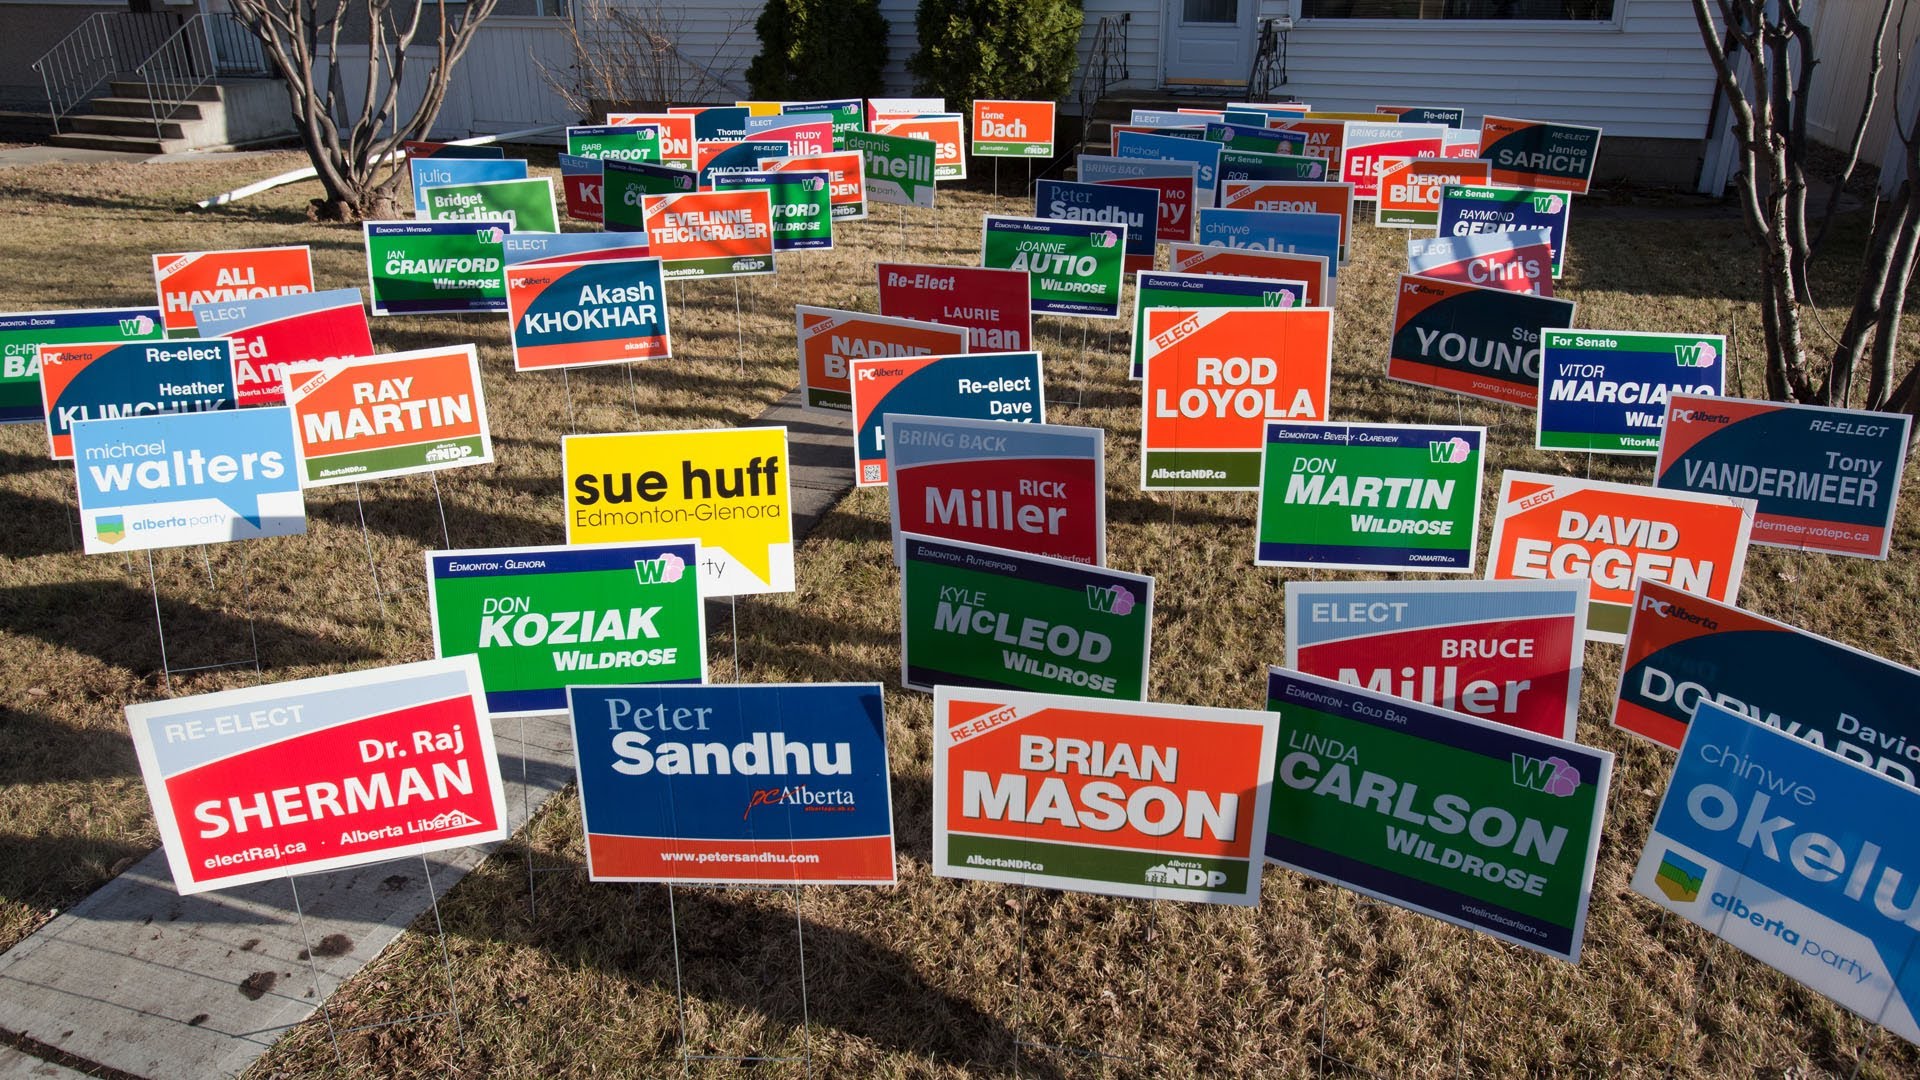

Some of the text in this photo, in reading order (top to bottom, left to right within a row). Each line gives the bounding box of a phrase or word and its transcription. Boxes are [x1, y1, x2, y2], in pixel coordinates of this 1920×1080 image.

[981, 112, 1004, 120] Lorne
[1134, 116, 1160, 124] ELECT
[1423, 111, 1458, 120] Re-elect
[716, 128, 746, 136] Thomas
[795, 132, 822, 140] RUDY
[981, 118, 1027, 138] Dach
[1350, 128, 1403, 138] BRING BACK
[1552, 131, 1591, 142] RE-ELECT
[600, 148, 651, 160] GROOT
[850, 136, 891, 153] dennis
[1122, 145, 1160, 157] michael
[1548, 144, 1588, 156] Janice
[562, 157, 589, 168] ELECT
[1238, 156, 1263, 164] Senate
[1418, 150, 1435, 159] MO
[1498, 149, 1586, 174] SARICH
[418, 168, 451, 186] julia
[1084, 163, 1117, 174] BRING
[1118, 165, 1145, 176] BACK
[1228, 172, 1249, 181] ROB
[1388, 162, 1405, 174] ELECT
[626, 183, 647, 192] JOHN
[1406, 174, 1460, 186] DERON
[434, 192, 484, 209] Bridget
[876, 187, 898, 197] party
[1050, 185, 1093, 204] Peter
[1166, 189, 1186, 200] MO
[1233, 188, 1252, 201] ELECT
[1449, 188, 1495, 199] For Senate
[650, 200, 668, 214] ELECT
[1049, 200, 1144, 228] Sandhu
[1254, 200, 1318, 212] DERON
[1459, 209, 1514, 222] RAYMOND
[664, 209, 752, 228] EVELINNE
[994, 222, 1021, 230] EDMONTON
[376, 226, 404, 234] EDMONTON
[652, 223, 768, 244] TEICHGRABER
[1205, 222, 1250, 236] chinwe
[506, 240, 548, 251] ELECT
[1016, 241, 1067, 254] JOANNE
[1411, 242, 1454, 256] ELECT
[387, 250, 406, 261] IAN
[1010, 252, 1098, 277] AUTIO
[1184, 254, 1206, 268] ELECT
[166, 257, 190, 275] ELECT
[385, 258, 500, 276] CRAWFORD
[1467, 255, 1541, 284] Chris
[216, 266, 256, 287] ALI
[433, 278, 500, 290] WILDROSE
[887, 272, 956, 292] Re-Elect
[1040, 278, 1107, 294] WILDROSE
[1148, 278, 1204, 290] EDMONTON CALDER
[578, 281, 655, 306] Akash
[30, 318, 56, 326] DECORE
[200, 306, 248, 324] ELECT
[524, 304, 658, 335] KHOKHAR
[944, 306, 1000, 322] LAURIE
[812, 319, 835, 335] ELECT
[1155, 315, 1201, 350] ELECT
[232, 336, 268, 360] Ed
[624, 341, 660, 351] akash.ca
[1552, 335, 1618, 349] For Senate
[42, 352, 94, 366] PCAlberta
[146, 346, 222, 363] Re-elect
[858, 368, 904, 382] PCAlberta
[1196, 357, 1278, 386] ROD
[1558, 362, 1606, 378] VITOR
[160, 382, 225, 397] Heather
[302, 373, 328, 396] ELECT
[352, 376, 414, 406] RAY
[958, 376, 1031, 395] Re-elect
[990, 400, 1032, 416] Dave
[1156, 388, 1318, 420] LOYOLA
[302, 393, 473, 445] MARTIN
[1671, 408, 1731, 425] PCAlberta
[1278, 429, 1320, 440] EDMONTON
[1359, 432, 1399, 444] CLAREVIEW
[1809, 418, 1890, 438] RE-ELECT
[85, 440, 166, 460] michael
[898, 430, 956, 448] BRING
[958, 432, 1008, 452] BACK
[88, 449, 286, 493] walters
[319, 464, 368, 478] AlbertaNDP.ca
[1151, 468, 1227, 480] AlbertaNDP.ca
[1292, 457, 1337, 474] DON
[1826, 450, 1884, 479] Tony
[574, 455, 780, 506] sue huff
[1019, 478, 1068, 500] RICK
[1684, 458, 1879, 509] VANDERMEER
[1284, 474, 1456, 510] MARTIN
[1519, 488, 1557, 511] ELECT
[576, 502, 781, 528] Edmonton-Glenora
[924, 485, 1068, 536] Miller
[132, 513, 227, 532] alberta party
[1350, 514, 1454, 536] WILDROSE
[1557, 510, 1680, 552] DAVID
[449, 558, 546, 572] EDMONTON GLENORA
[917, 546, 1018, 573] EDMONTON RUTHERFORD
[1408, 553, 1456, 564] DONMARTIN.CA
[1510, 537, 1715, 598] EGGEN
[482, 596, 531, 615] DON
[940, 585, 987, 608] KYLE
[1312, 602, 1409, 624] ELECT
[1640, 594, 1718, 631] PCAlberta
[478, 606, 664, 648] KOZIAK
[1440, 638, 1535, 659] BRUCE
[552, 647, 678, 672] WILDROSE
[1002, 649, 1118, 694] WILDROSE
[1336, 665, 1532, 714] Miller
[1286, 683, 1408, 726] EDMONTON GOLD BAR
[164, 704, 306, 744] RE-ELECT
[604, 697, 714, 732] Peter
[950, 705, 1018, 744] RE-ELECT
[358, 724, 466, 764] Dr. Raj
[610, 730, 854, 776] Sandhu
[1289, 728, 1360, 766] LINDA
[1019, 734, 1180, 784] BRIAN
[1700, 742, 1818, 808] chinwe
[194, 758, 474, 840] SHERMAN
[962, 769, 1240, 843] MASON
[1278, 751, 1570, 866] CARLSON
[204, 814, 468, 870] electRaj.ca Alberta Liberal
[660, 852, 820, 865] www.petersandhu.com
[966, 854, 1044, 873] AlbertaNDP.ca
[1166, 858, 1203, 870] Alberta's
[1386, 824, 1549, 897] WILDROSE
[1686, 782, 1920, 932] okelu
[1460, 903, 1549, 940] votelindacarlson.ca
[1710, 890, 1874, 985] alberta party
